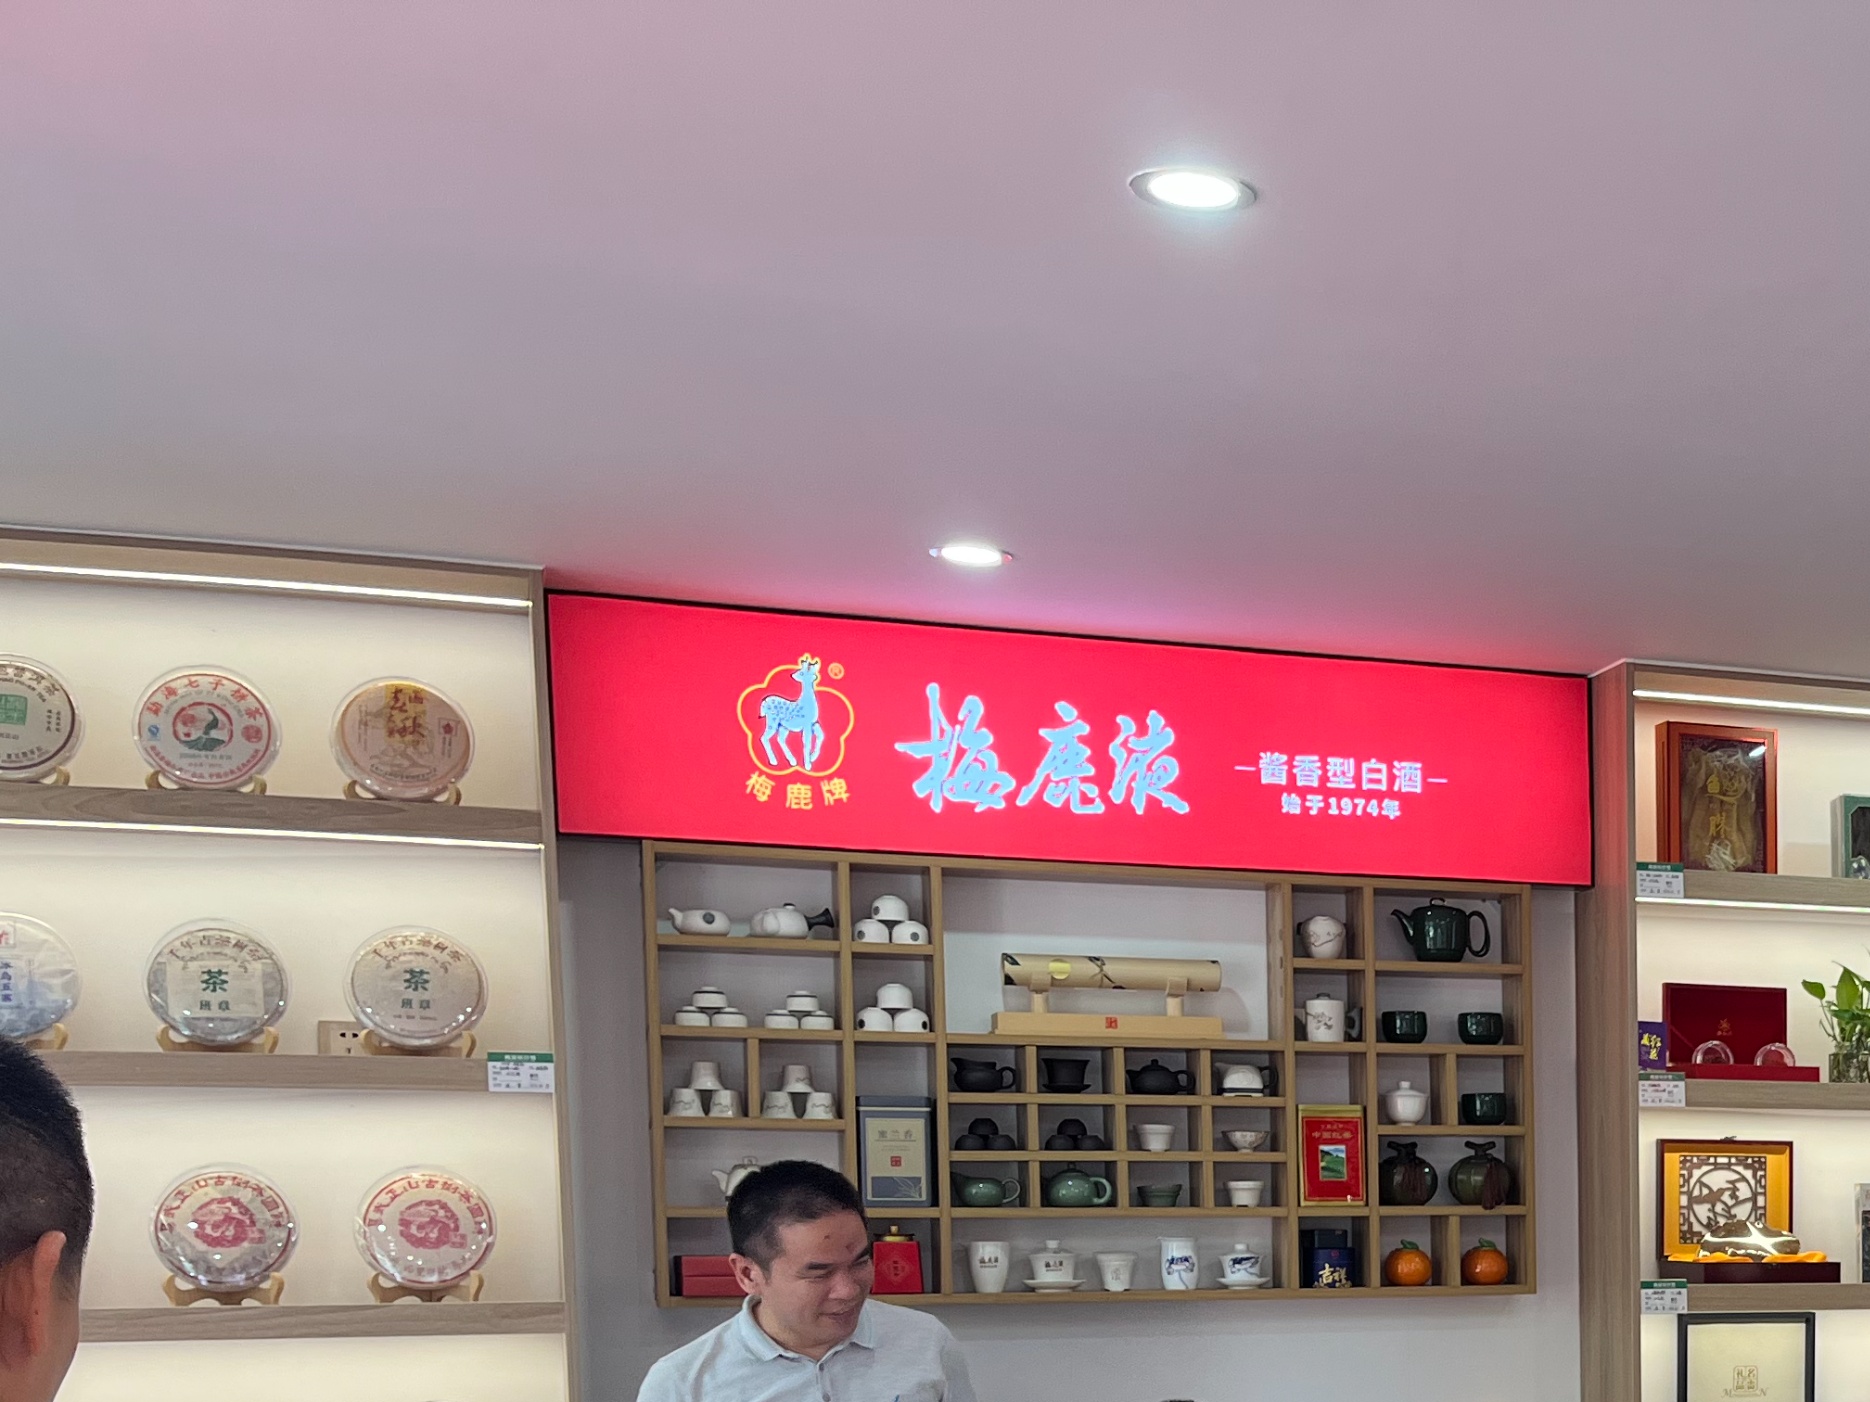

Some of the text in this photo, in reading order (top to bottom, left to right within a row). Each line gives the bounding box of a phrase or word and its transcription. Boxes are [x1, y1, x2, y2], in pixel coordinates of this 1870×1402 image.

[894, 682, 1190, 815] 梅鹿液
[1259, 751, 1423, 793] 酱香型白酒
[744, 771, 850, 810] 梅鹿牌
[1281, 793, 1402, 820] 始于1974年
[201, 969, 229, 993] 茶
[403, 969, 431, 992] 茶
